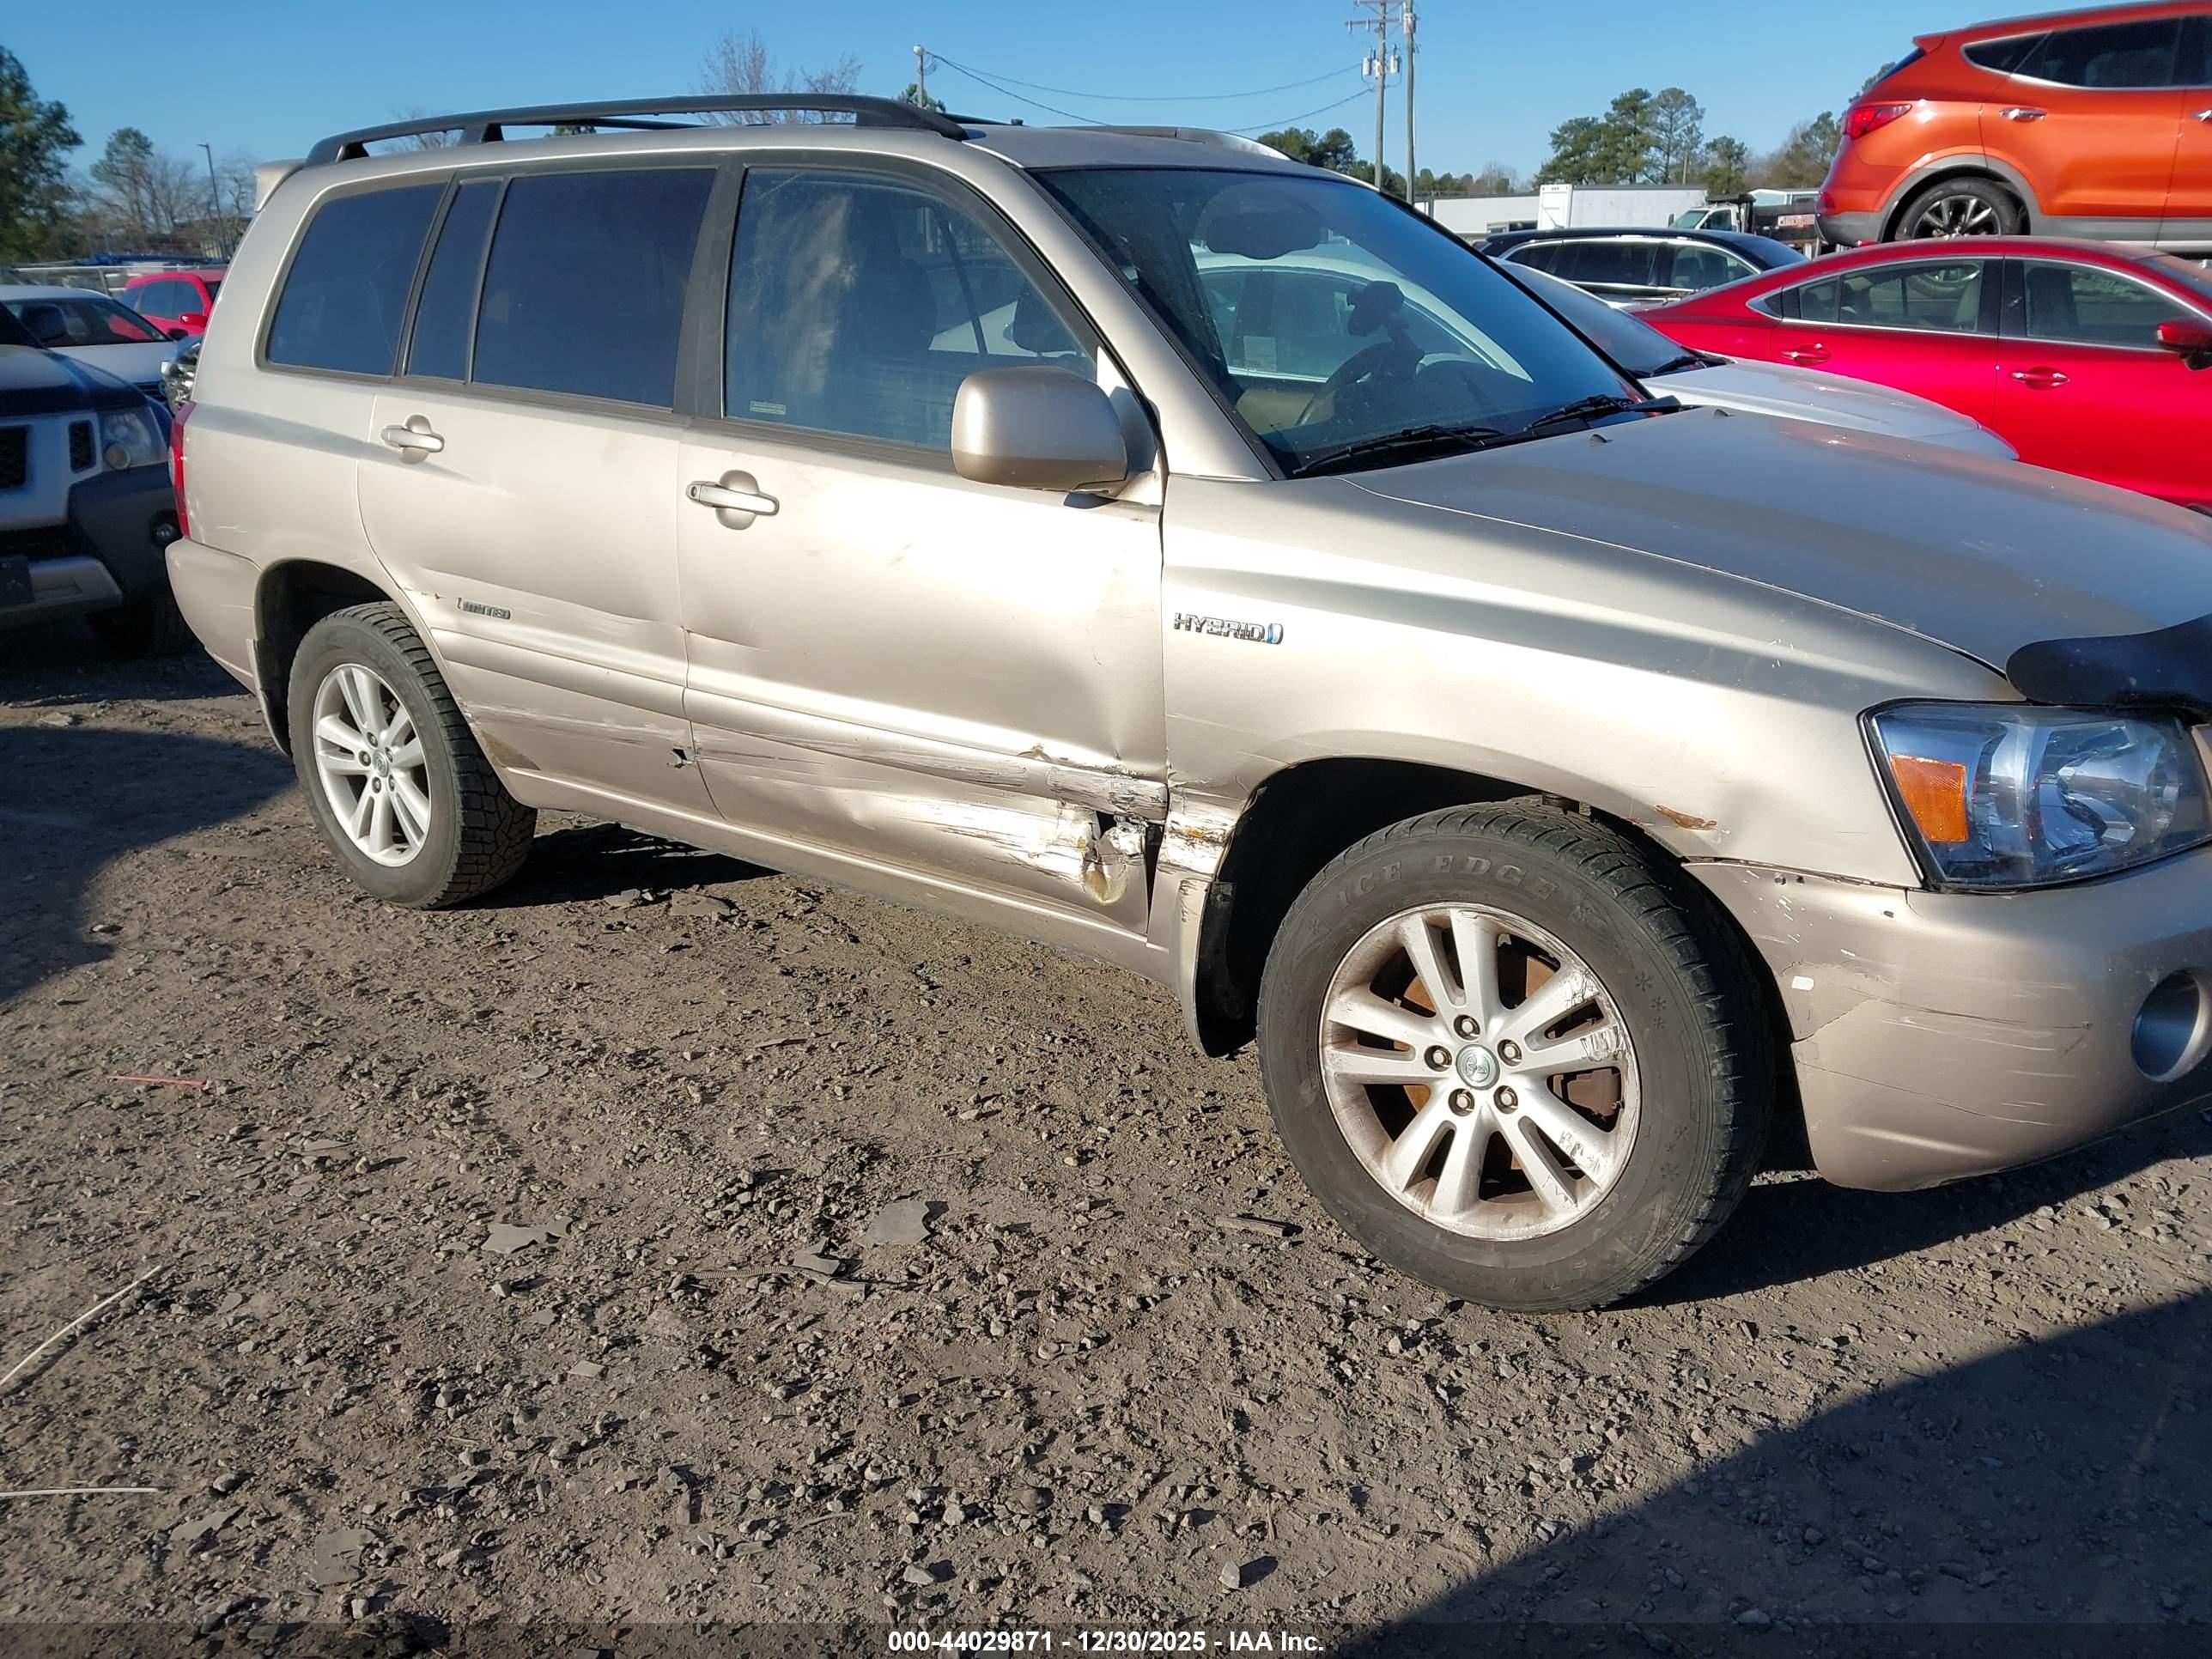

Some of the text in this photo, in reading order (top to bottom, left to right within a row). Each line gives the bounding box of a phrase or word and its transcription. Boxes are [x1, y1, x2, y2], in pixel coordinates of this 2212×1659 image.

[1173, 611, 1265, 643] HYBRID
[1338, 854, 1560, 911] ICE EDGE
